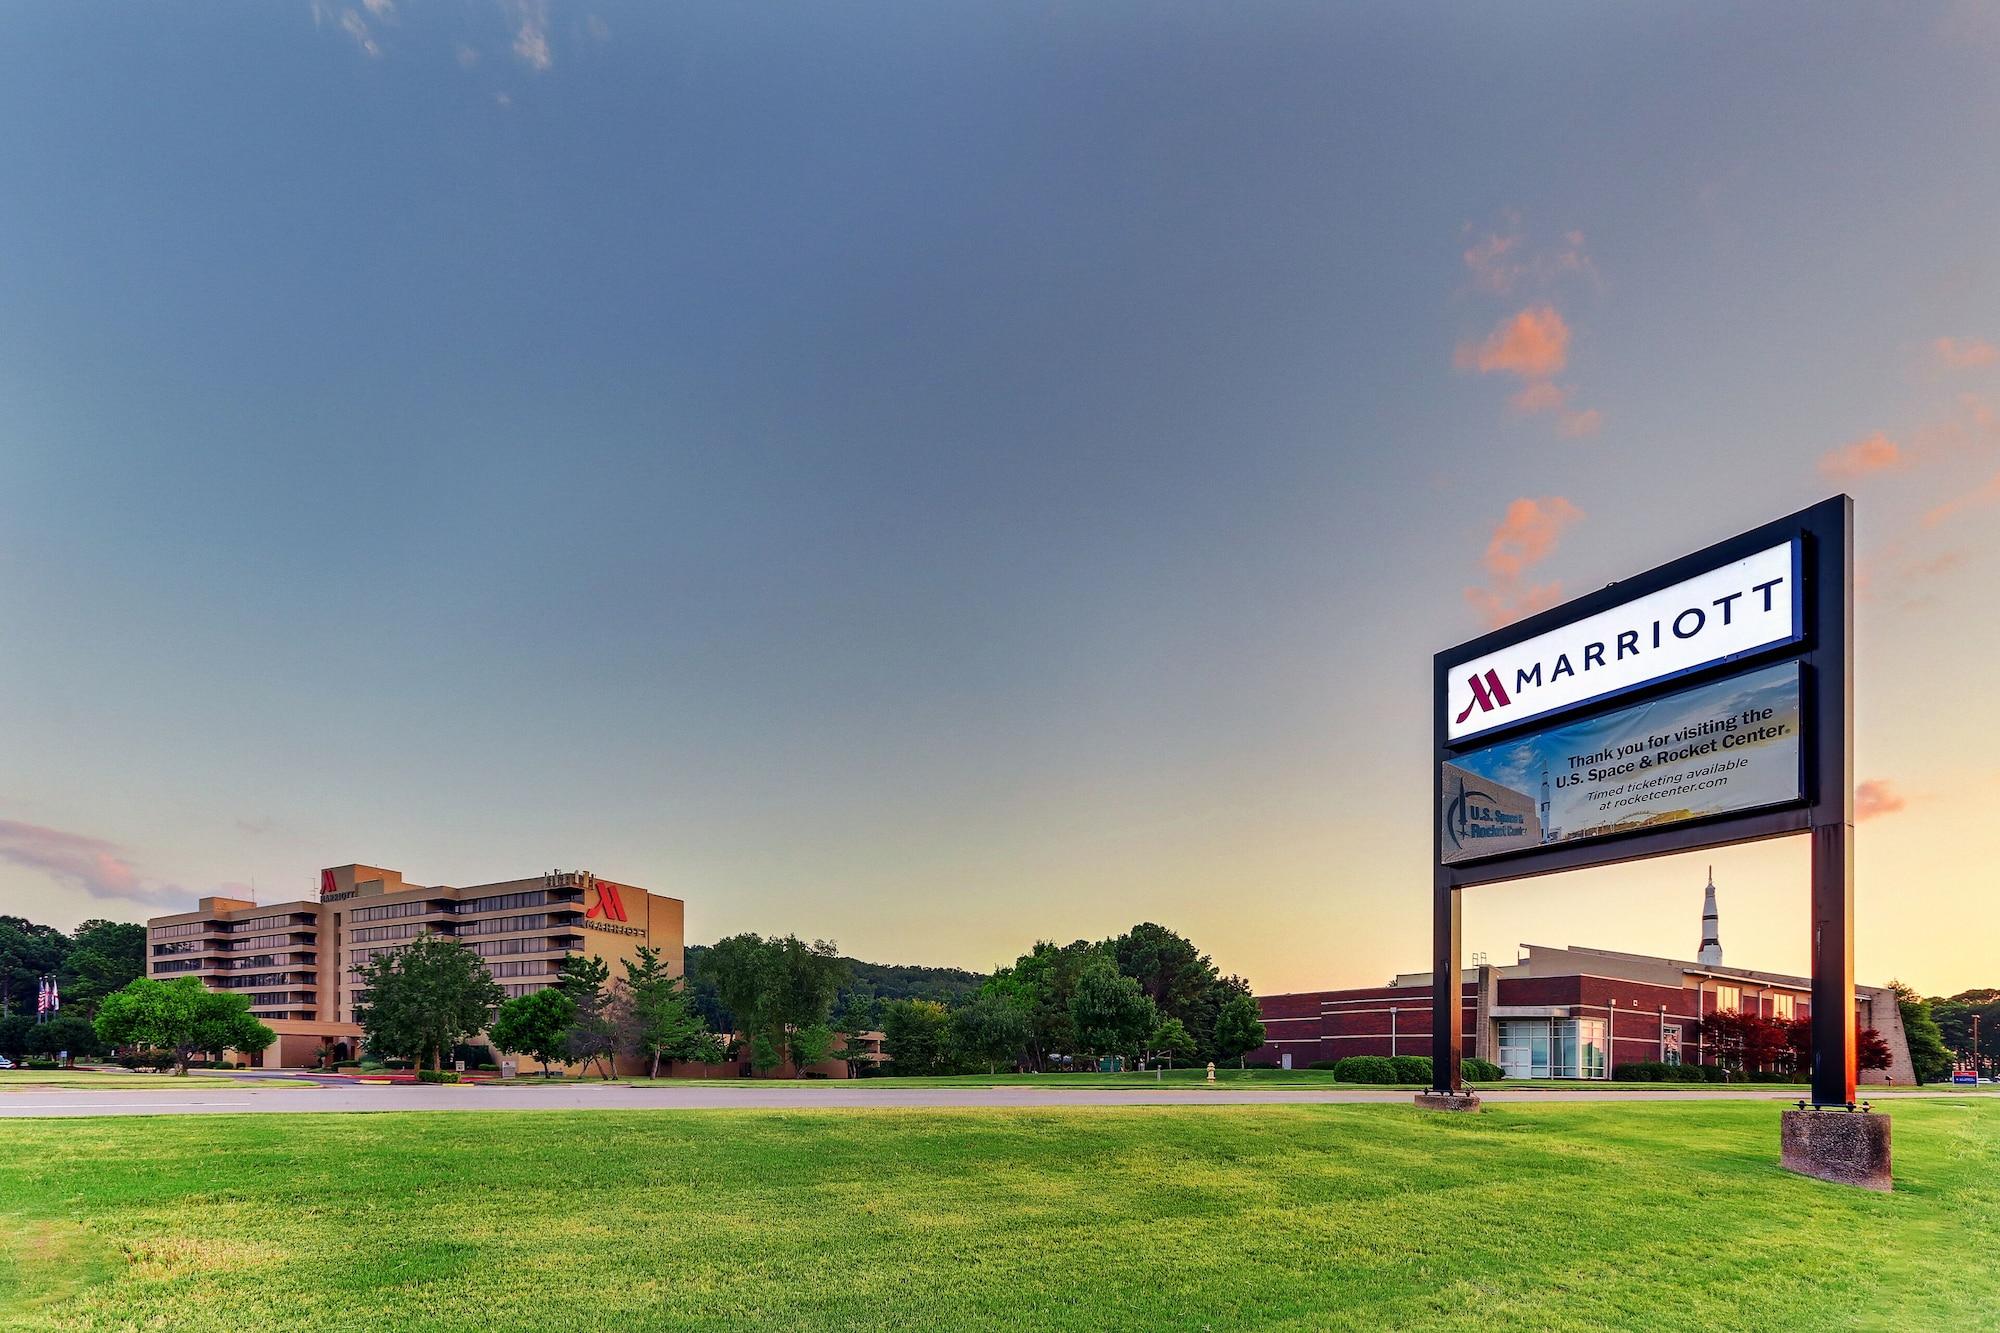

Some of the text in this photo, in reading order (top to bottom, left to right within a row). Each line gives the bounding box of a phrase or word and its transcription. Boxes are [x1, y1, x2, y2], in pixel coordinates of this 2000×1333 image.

[1516, 577, 1783, 693] MARRIOTT
[1568, 707, 1773, 769] Thank you for visiting the
[1556, 772, 1584, 789] U.S.
[1588, 760, 1634, 783] Space
[1639, 755, 1652, 768] &
[1657, 738, 1717, 765] Rocket
[1587, 757, 1749, 801] Timed ticketing available
[1599, 776, 1727, 811] at rocketcenter.com
[586, 919, 647, 938] MARRIOTT
